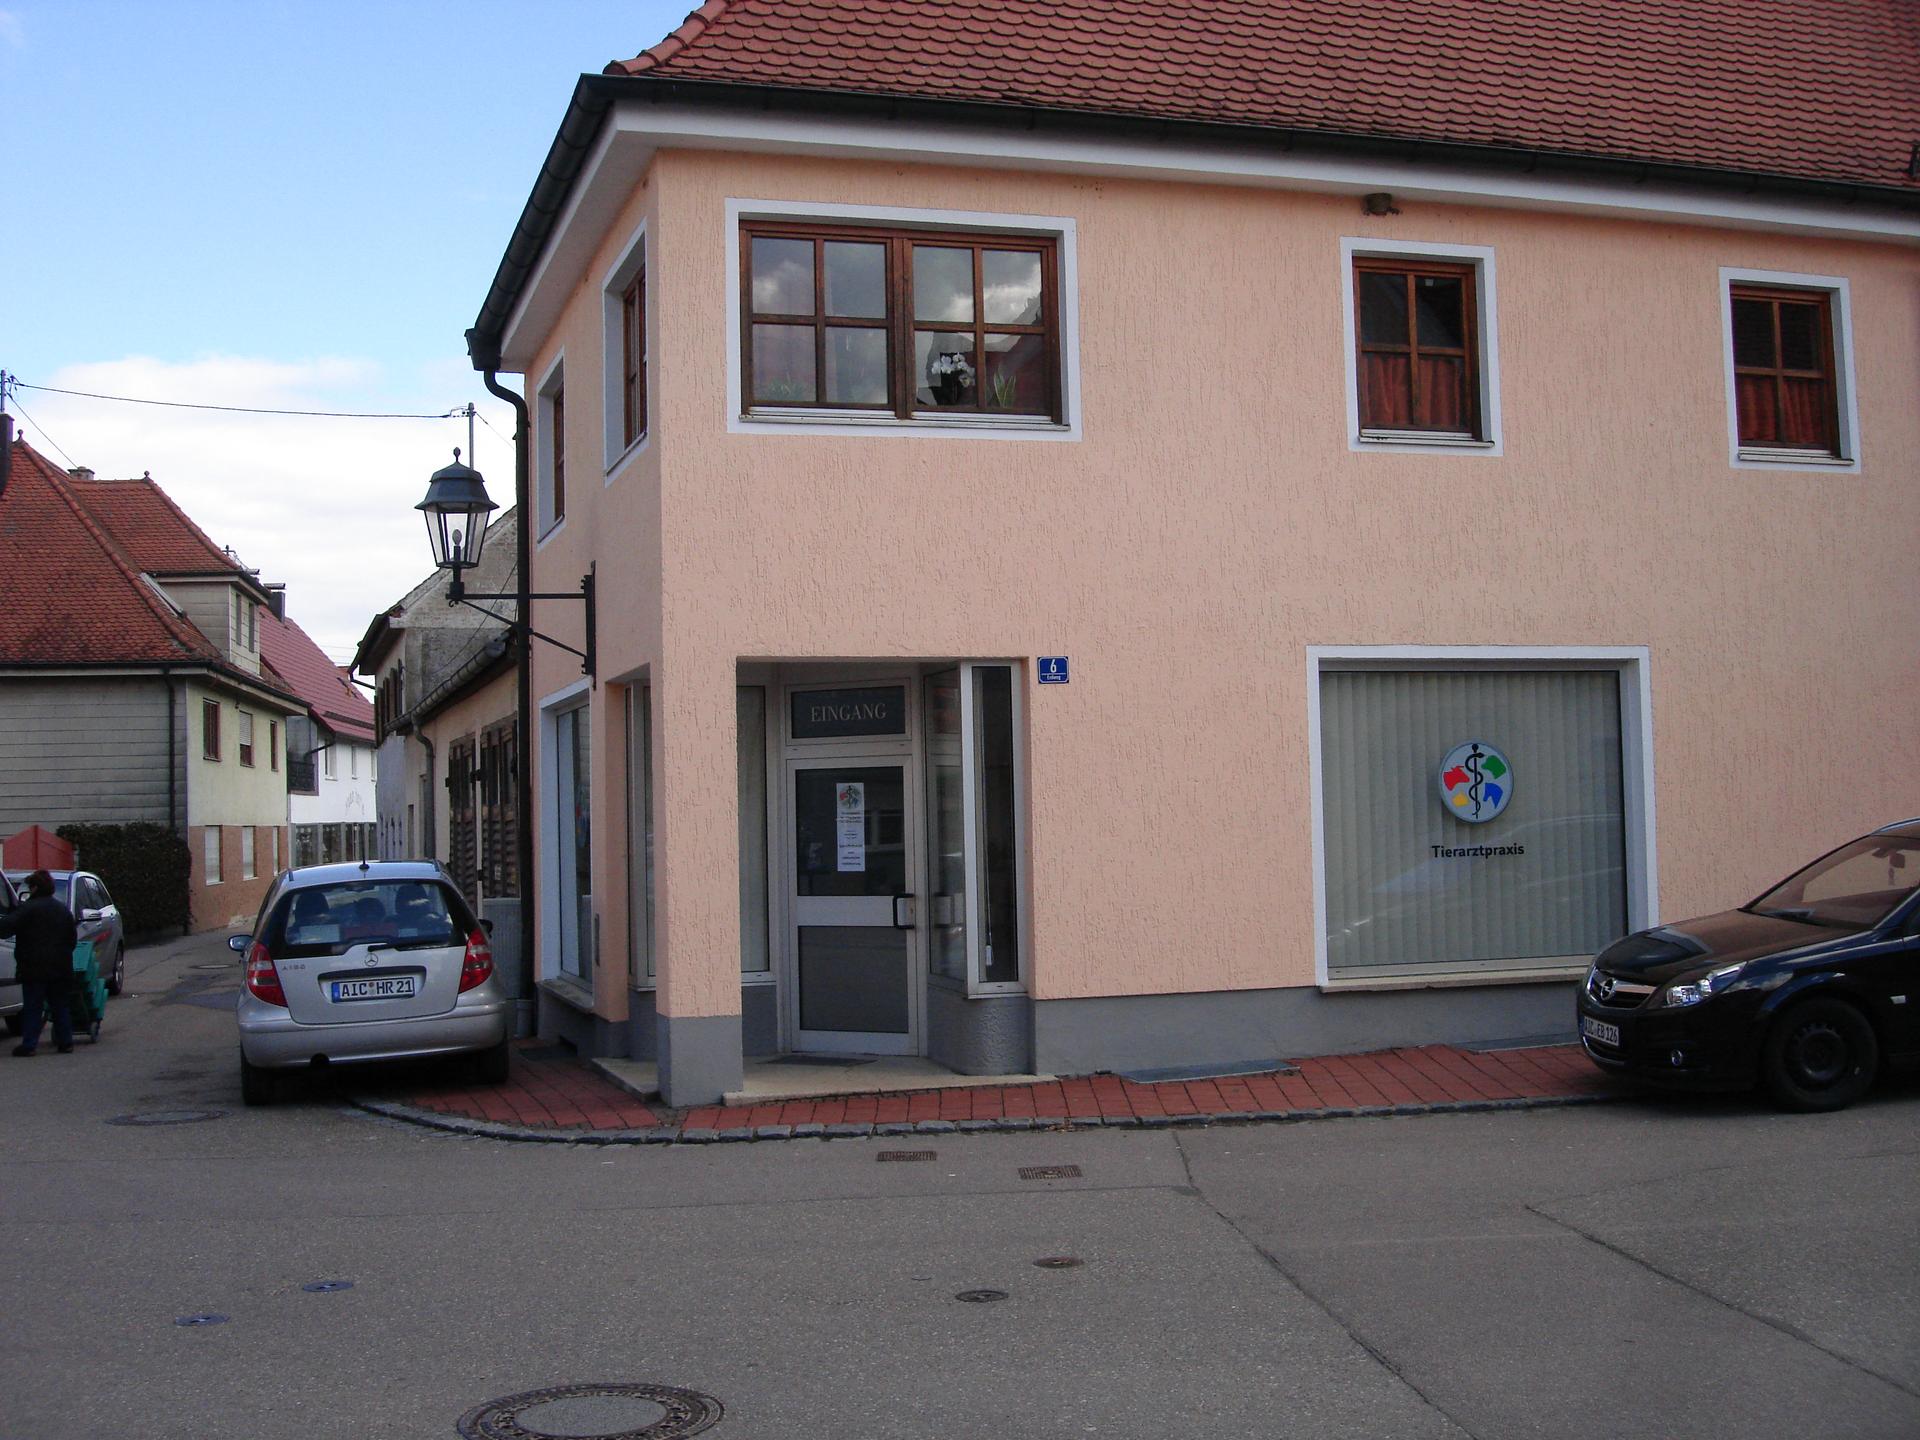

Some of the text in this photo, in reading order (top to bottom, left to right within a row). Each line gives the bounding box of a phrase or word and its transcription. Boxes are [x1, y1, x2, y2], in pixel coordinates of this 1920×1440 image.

[1050, 658, 1057, 673] 6
[811, 703, 887, 722] EINGANG
[1431, 843, 1525, 859] Tierarztpraxis
[341, 979, 413, 997] AIC HR 21
